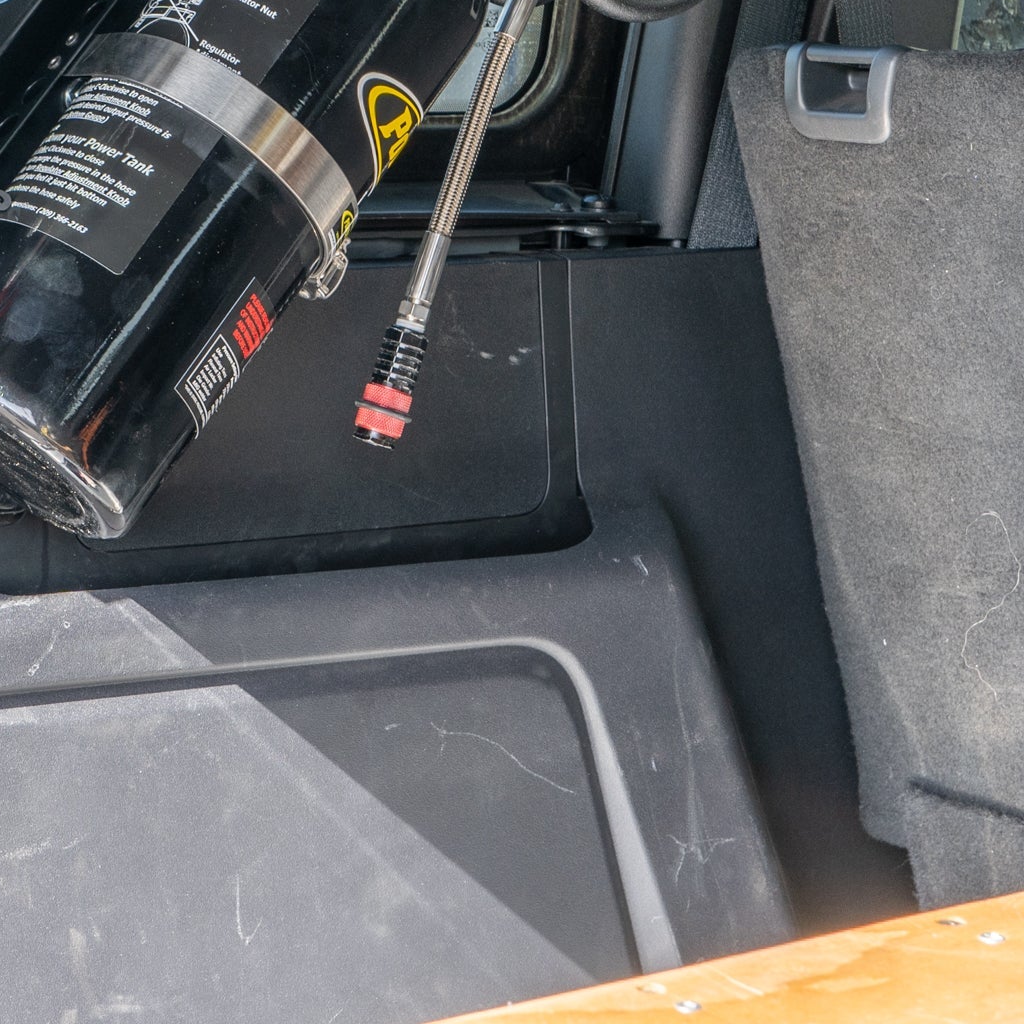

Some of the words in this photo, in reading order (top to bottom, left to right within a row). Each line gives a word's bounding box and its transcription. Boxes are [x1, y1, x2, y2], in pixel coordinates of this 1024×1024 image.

[259, 4, 278, 19] Nut
[198, 38, 241, 66] Regulator
[128, 88, 139, 98] to
[136, 92, 159, 108] open
[128, 101, 151, 118] Knob
[102, 103, 128, 120] output
[125, 113, 163, 136] pressure
[161, 129, 172, 140] is
[60, 133, 88, 147] your
[83, 135, 123, 162] Power
[120, 151, 156, 178] Tank
[74, 149, 85, 159] to
[83, 152, 105, 167] close
[50, 154, 63, 163] the
[59, 157, 92, 176] pressure
[90, 168, 101, 178] in
[99, 172, 116, 185] the
[113, 179, 137, 197] hose
[62, 168, 108, 195] Adjustment
[105, 187, 131, 207] Knob
[28, 184, 41, 193] the
[38, 187, 57, 199] hose
[54, 192, 81, 211] safely
[33, 173, 48, 181] feel
[48, 176, 67, 188] just
[63, 181, 78, 192] hit
[76, 186, 108, 207] bottom
[53, 212, 89, 234] 366-2163
